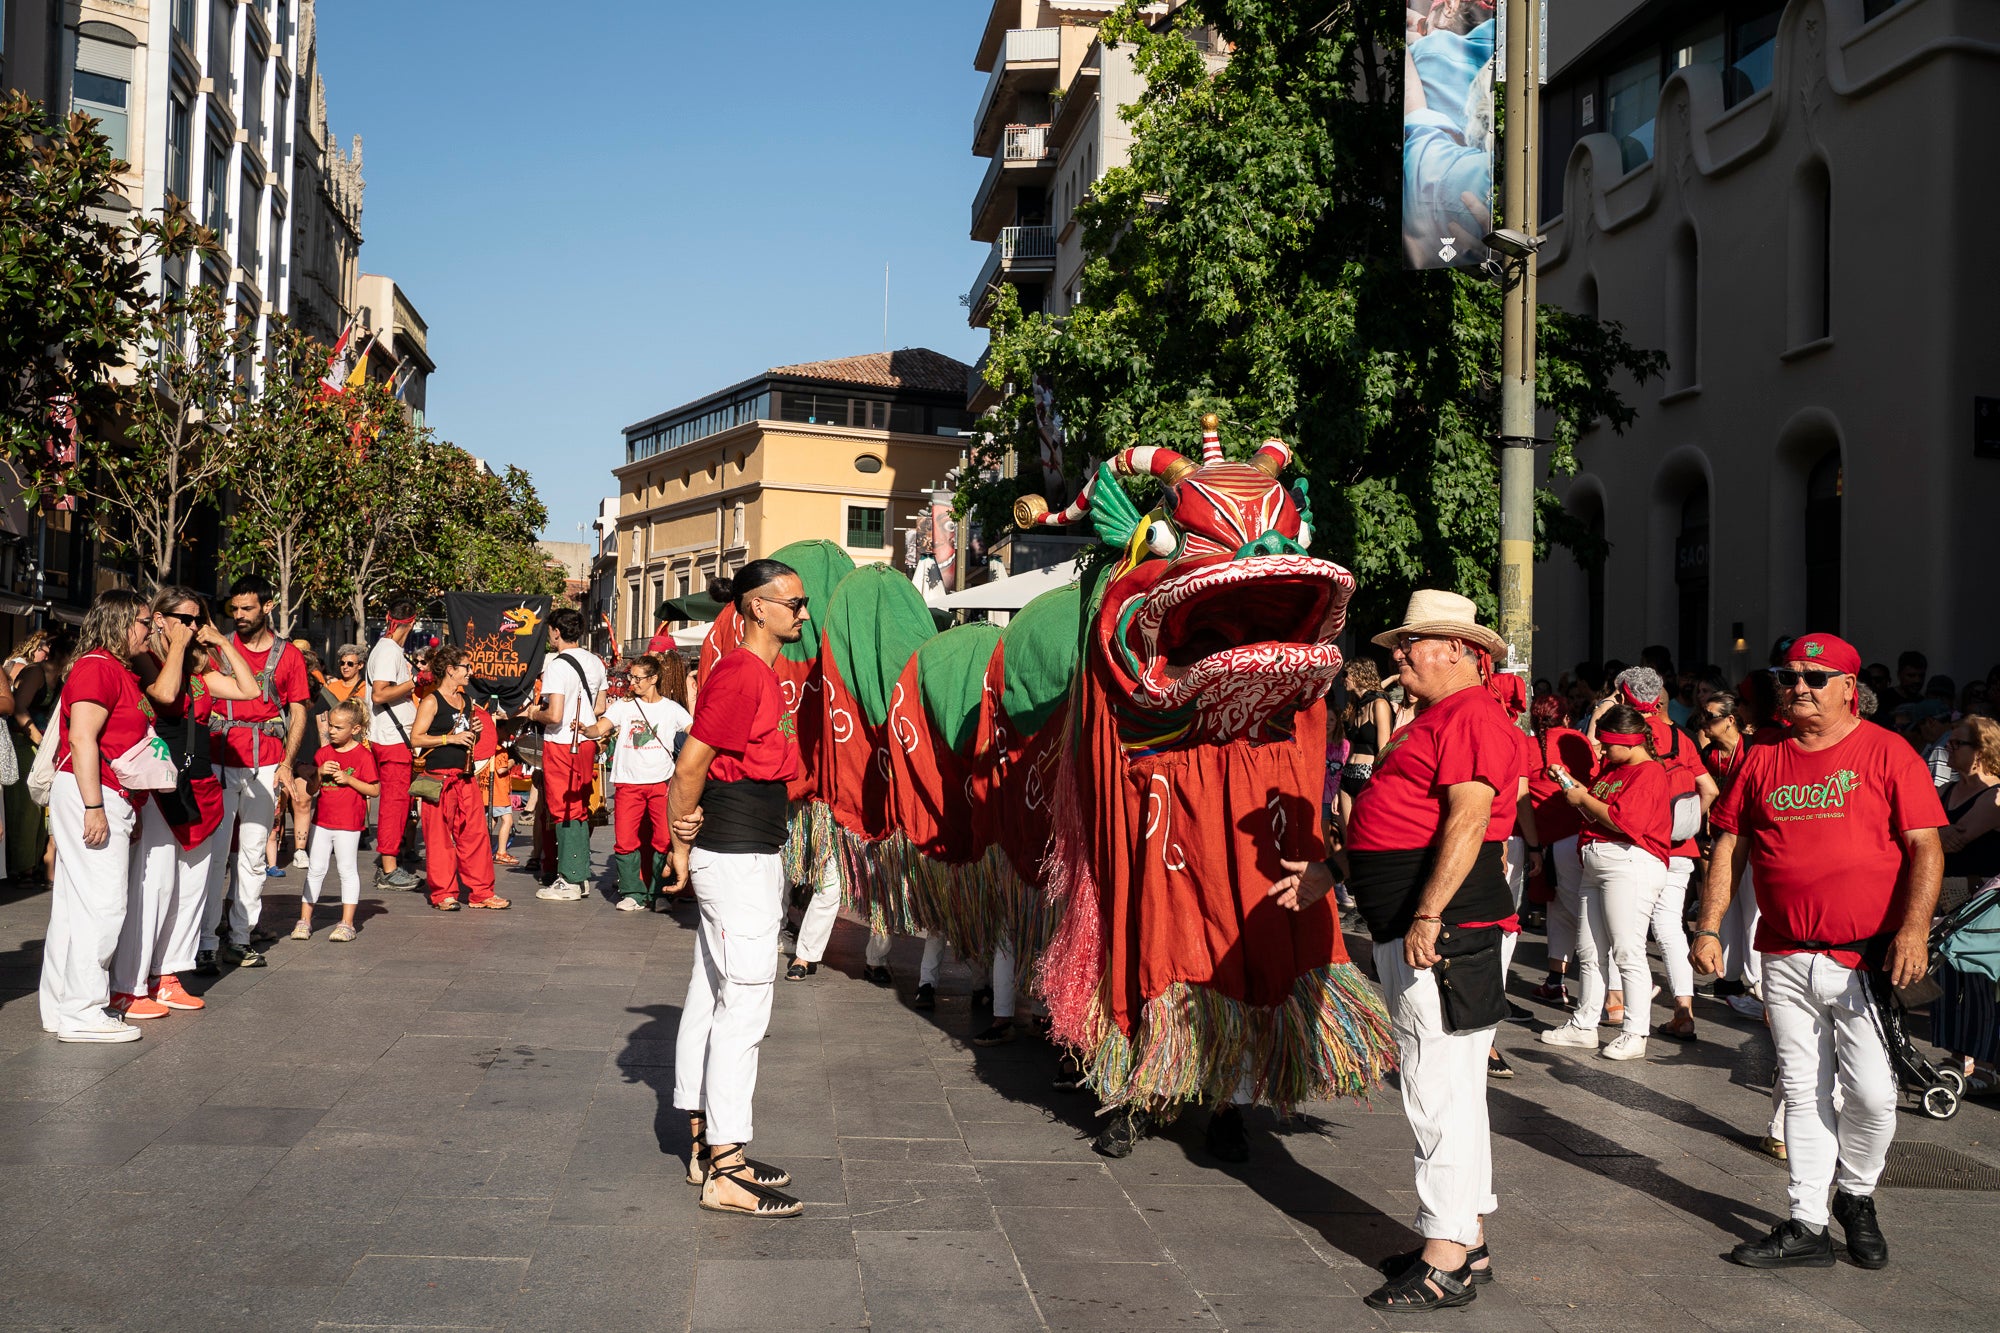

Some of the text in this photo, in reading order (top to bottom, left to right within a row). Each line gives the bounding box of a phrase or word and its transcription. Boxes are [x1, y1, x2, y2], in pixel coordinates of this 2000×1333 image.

[1679, 544, 1708, 568] SAO
[464, 650, 519, 663] DIABLES
[1772, 777, 1845, 811] CUCA
